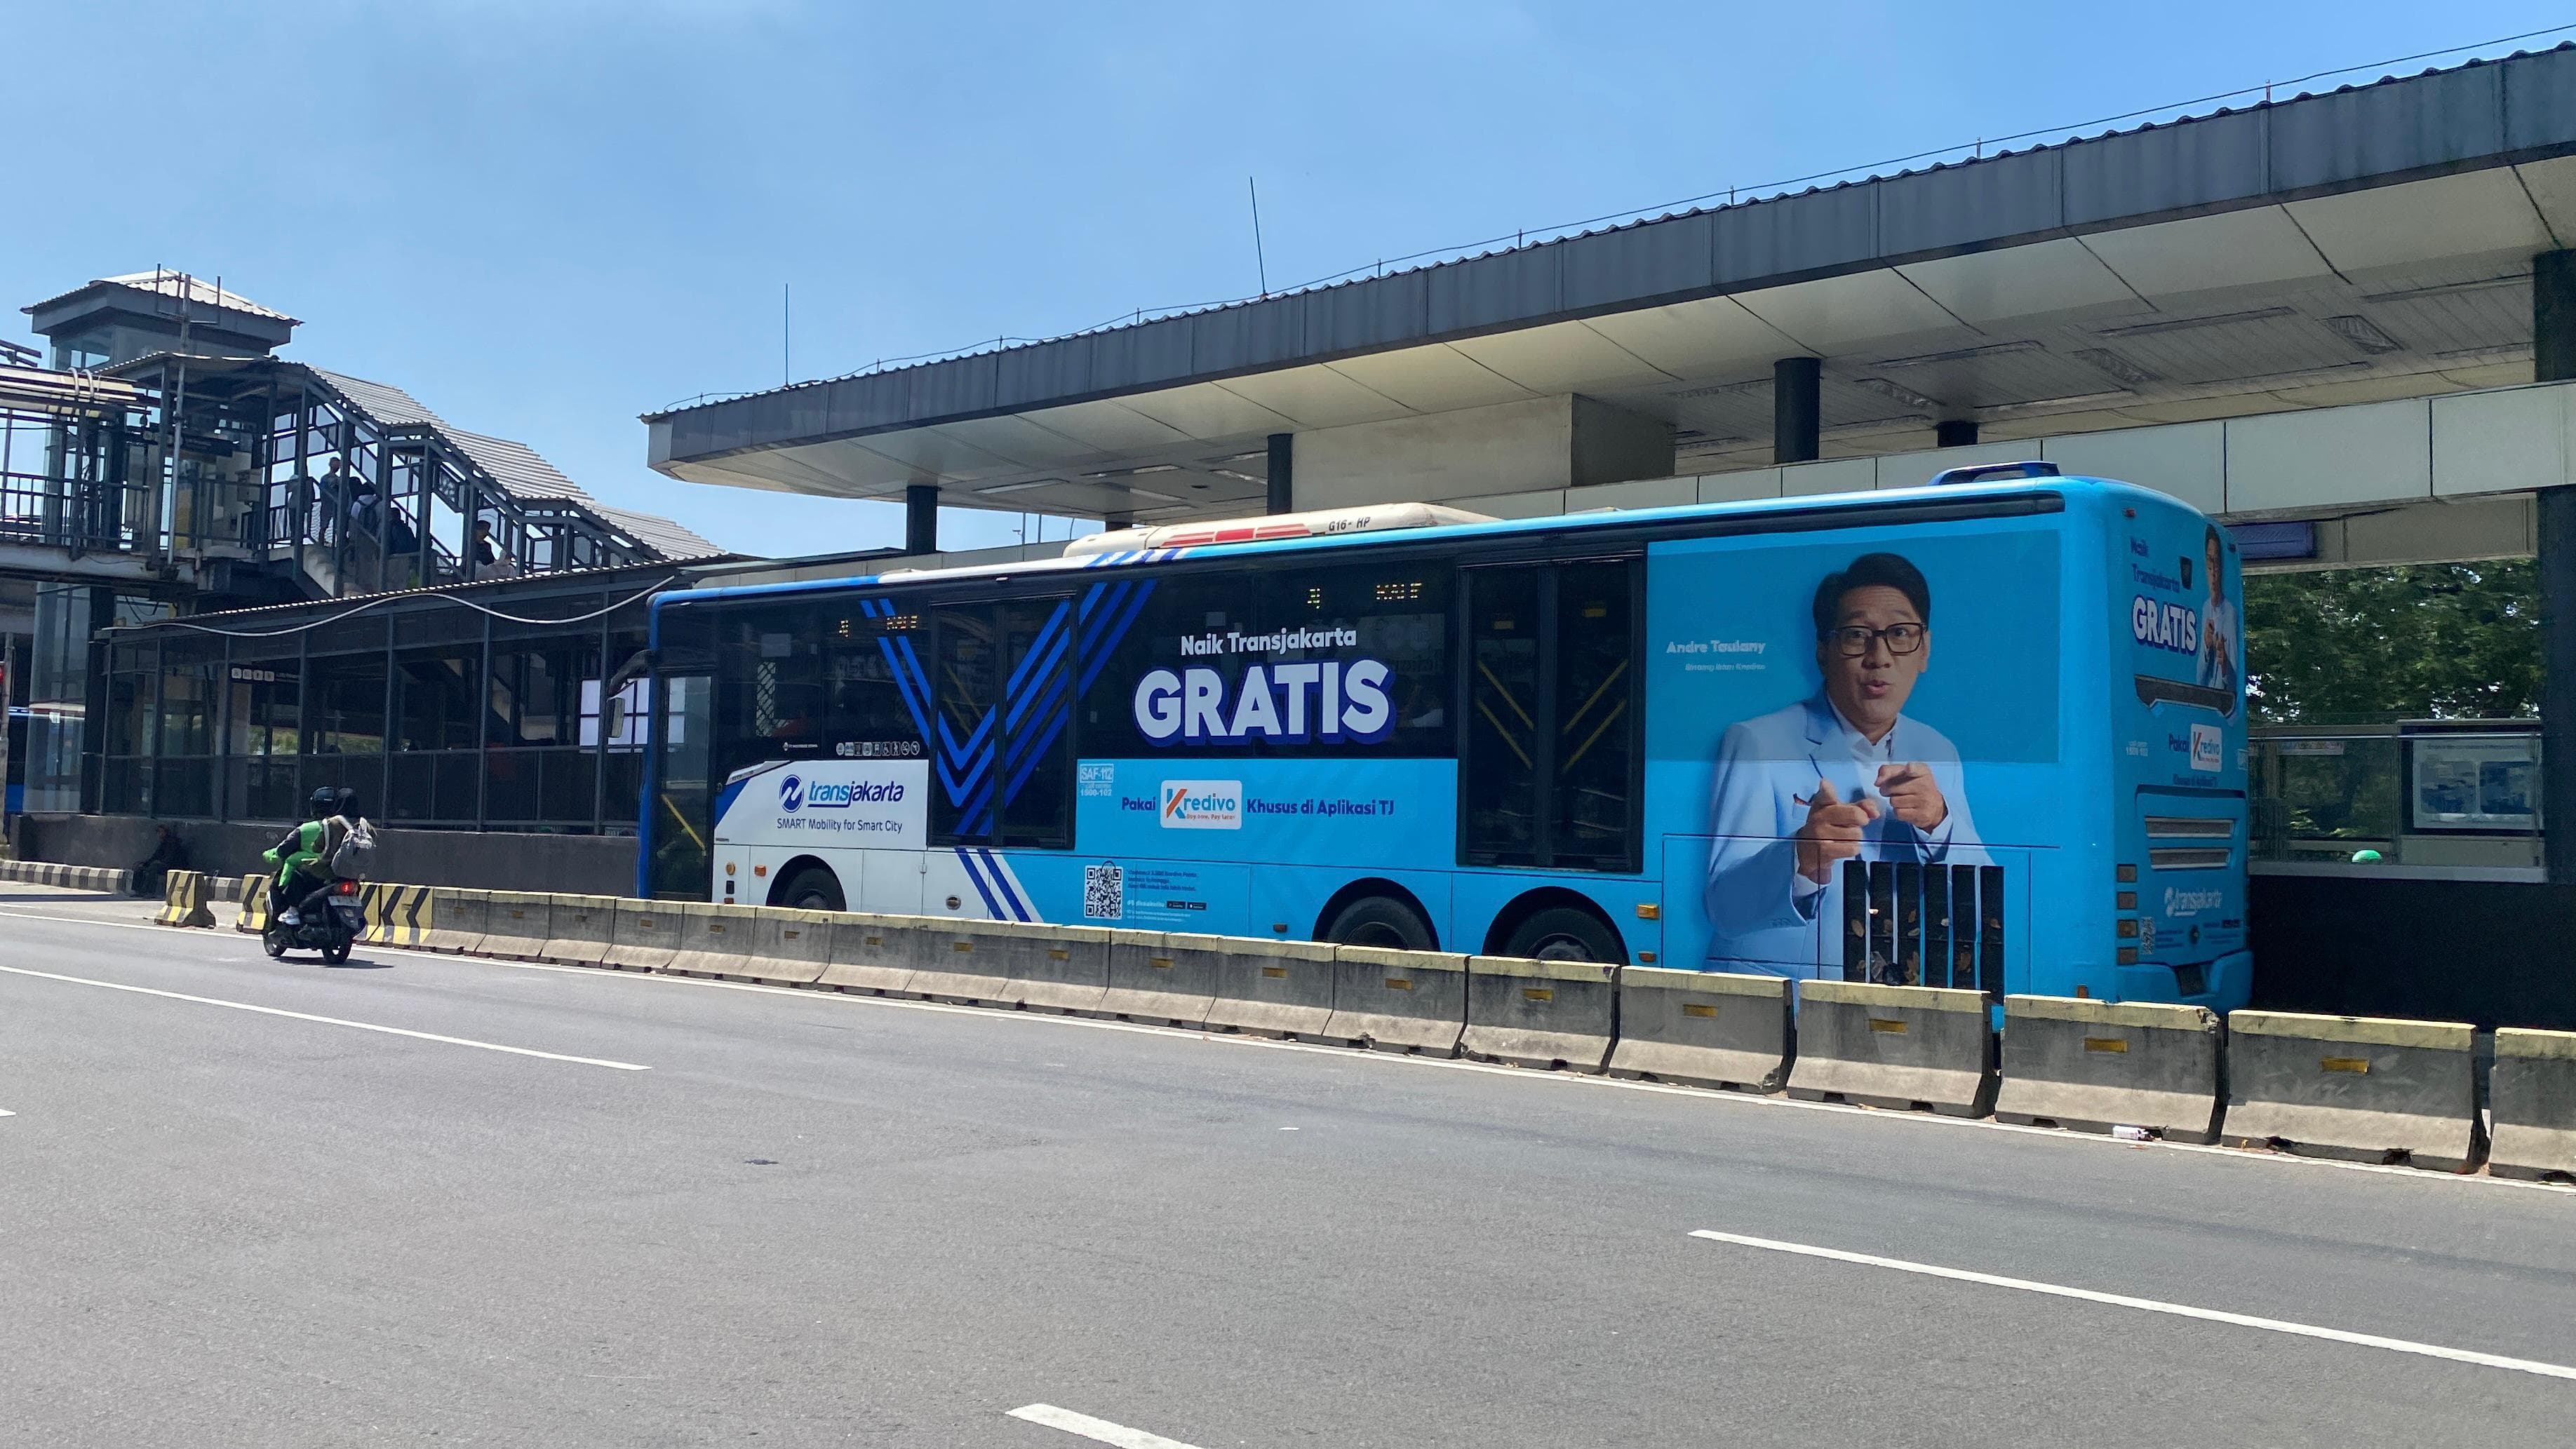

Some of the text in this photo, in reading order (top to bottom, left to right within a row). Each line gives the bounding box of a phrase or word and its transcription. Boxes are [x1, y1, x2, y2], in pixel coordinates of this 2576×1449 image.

[1356, 516, 1371, 529] HP
[2133, 596, 2197, 652] GRATIS
[1181, 627, 1357, 656] Naik Transjakarta
[1665, 639, 1766, 654] Andre Taulany
[1134, 659, 1390, 739] GRATIS
[807, 781, 904, 808] transjakarta
[1122, 788, 1395, 819] Pakai Kredivo Khusus di Aplikasi TJ
[777, 818, 903, 835] SMART Mobility for Smart City
